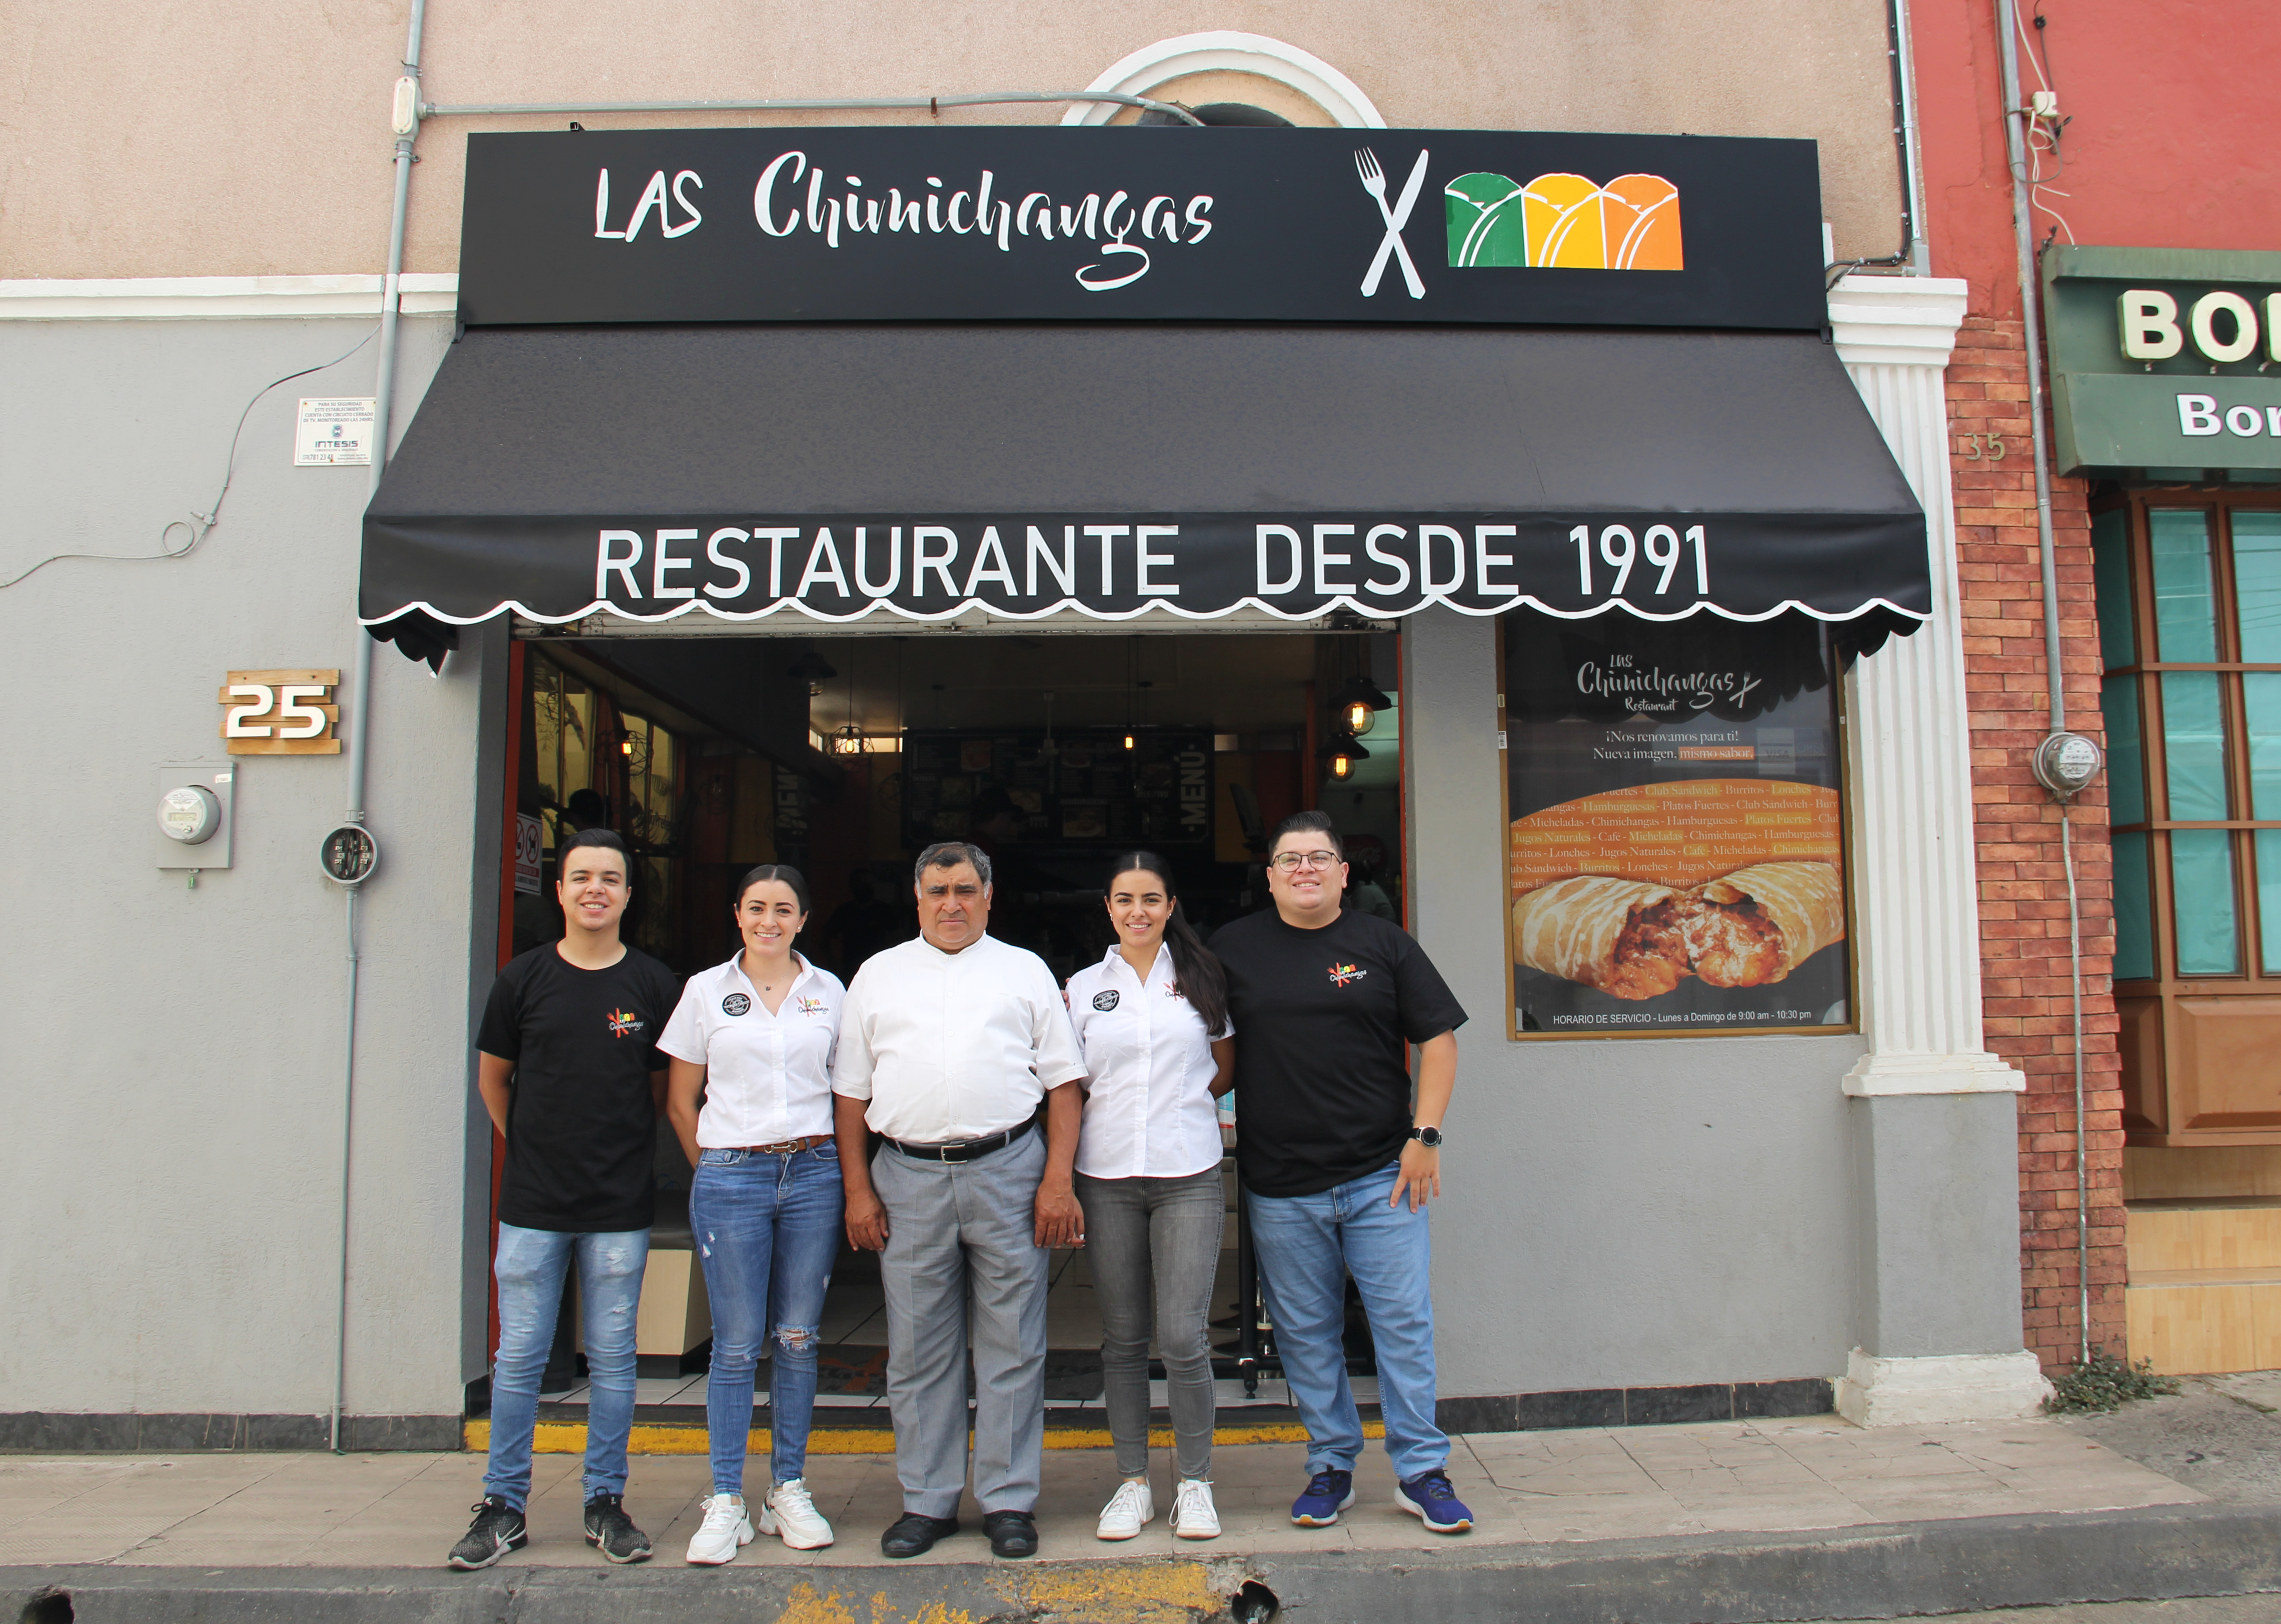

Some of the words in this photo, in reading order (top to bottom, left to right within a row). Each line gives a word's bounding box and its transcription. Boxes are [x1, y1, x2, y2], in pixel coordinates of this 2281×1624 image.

[594, 168, 703, 243] LAS
[754, 151, 1213, 291] Chimichangas
[1963, 433, 2006, 461] 35
[597, 525, 1179, 598] RESTAURANTE
[1256, 524, 1519, 595] DESDE
[1569, 524, 1708, 595] 1991
[1577, 661, 1734, 709] Chimichangas
[1625, 696, 1679, 711] Restaurant
[226, 685, 327, 738] 25
[1606, 731, 1635, 743] ¡Nos
[1637, 733, 1697, 742] renovamos
[1700, 733, 1724, 744] para
[1727, 731, 1739, 742] ti!
[1593, 747, 1631, 759] Nueva
[1633, 748, 1677, 762] imagen,
[1679, 748, 1717, 759] mismo
[1719, 747, 1753, 759] sabor.
[1173, 752, 1206, 825] MENÚ
[1645, 785, 1669, 795] Club
[1671, 785, 1718, 795] Sándwich
[1725, 785, 1764, 795] Burritos
[1772, 784, 1811, 794] Lonches
[1583, 802, 1655, 814] Hamburguesas
[1662, 801, 1692, 810] Platos
[1695, 800, 1729, 810] Fuertes
[1736, 799, 1760, 809] Club
[1762, 799, 1808, 808] Sándwich
[1530, 817, 1584, 827] Micheladas
[1591, 817, 1660, 828] Chimichangas
[1666, 816, 1738, 827] Hamburguesas
[1745, 815, 1774, 824] Platos
[1776, 814, 1811, 823] Fuertes
[1515, 833, 1541, 845] Jugos
[1544, 832, 1591, 842] Naturales
[1598, 832, 1621, 841] Café
[1629, 831, 1683, 841] Micheladas
[1689, 831, 1756, 842] Chimichangas
[1764, 829, 1834, 840] Hamburguesas
[1549, 848, 1590, 858] Lonches
[1600, 847, 1627, 859] Jugos
[1630, 846, 1676, 856] Naturales
[1683, 846, 1705, 855] Café
[1713, 845, 1766, 855] Micheladas
[1773, 844, 1839, 856] Chimichangas
[1525, 863, 1572, 873] Sándwich
[1580, 862, 1620, 872] Burritos
[1627, 862, 1667, 871] Lonches
[1677, 861, 1704, 873] Jugos
[1660, 877, 1699, 886] Burritos
[1553, 1015, 1594, 1024] HORARIO
[1596, 1014, 1608, 1023] DE
[1610, 1013, 1651, 1023] SERVICIO
[1658, 1013, 1682, 1022] Lunes
[1690, 1012, 1725, 1023] Domingo
[1727, 1011, 1736, 1020] de
[1738, 1011, 1755, 1020] 9:00
[1776, 1010, 1797, 1019] 10:30
[1799, 1011, 1812, 1020] pm
